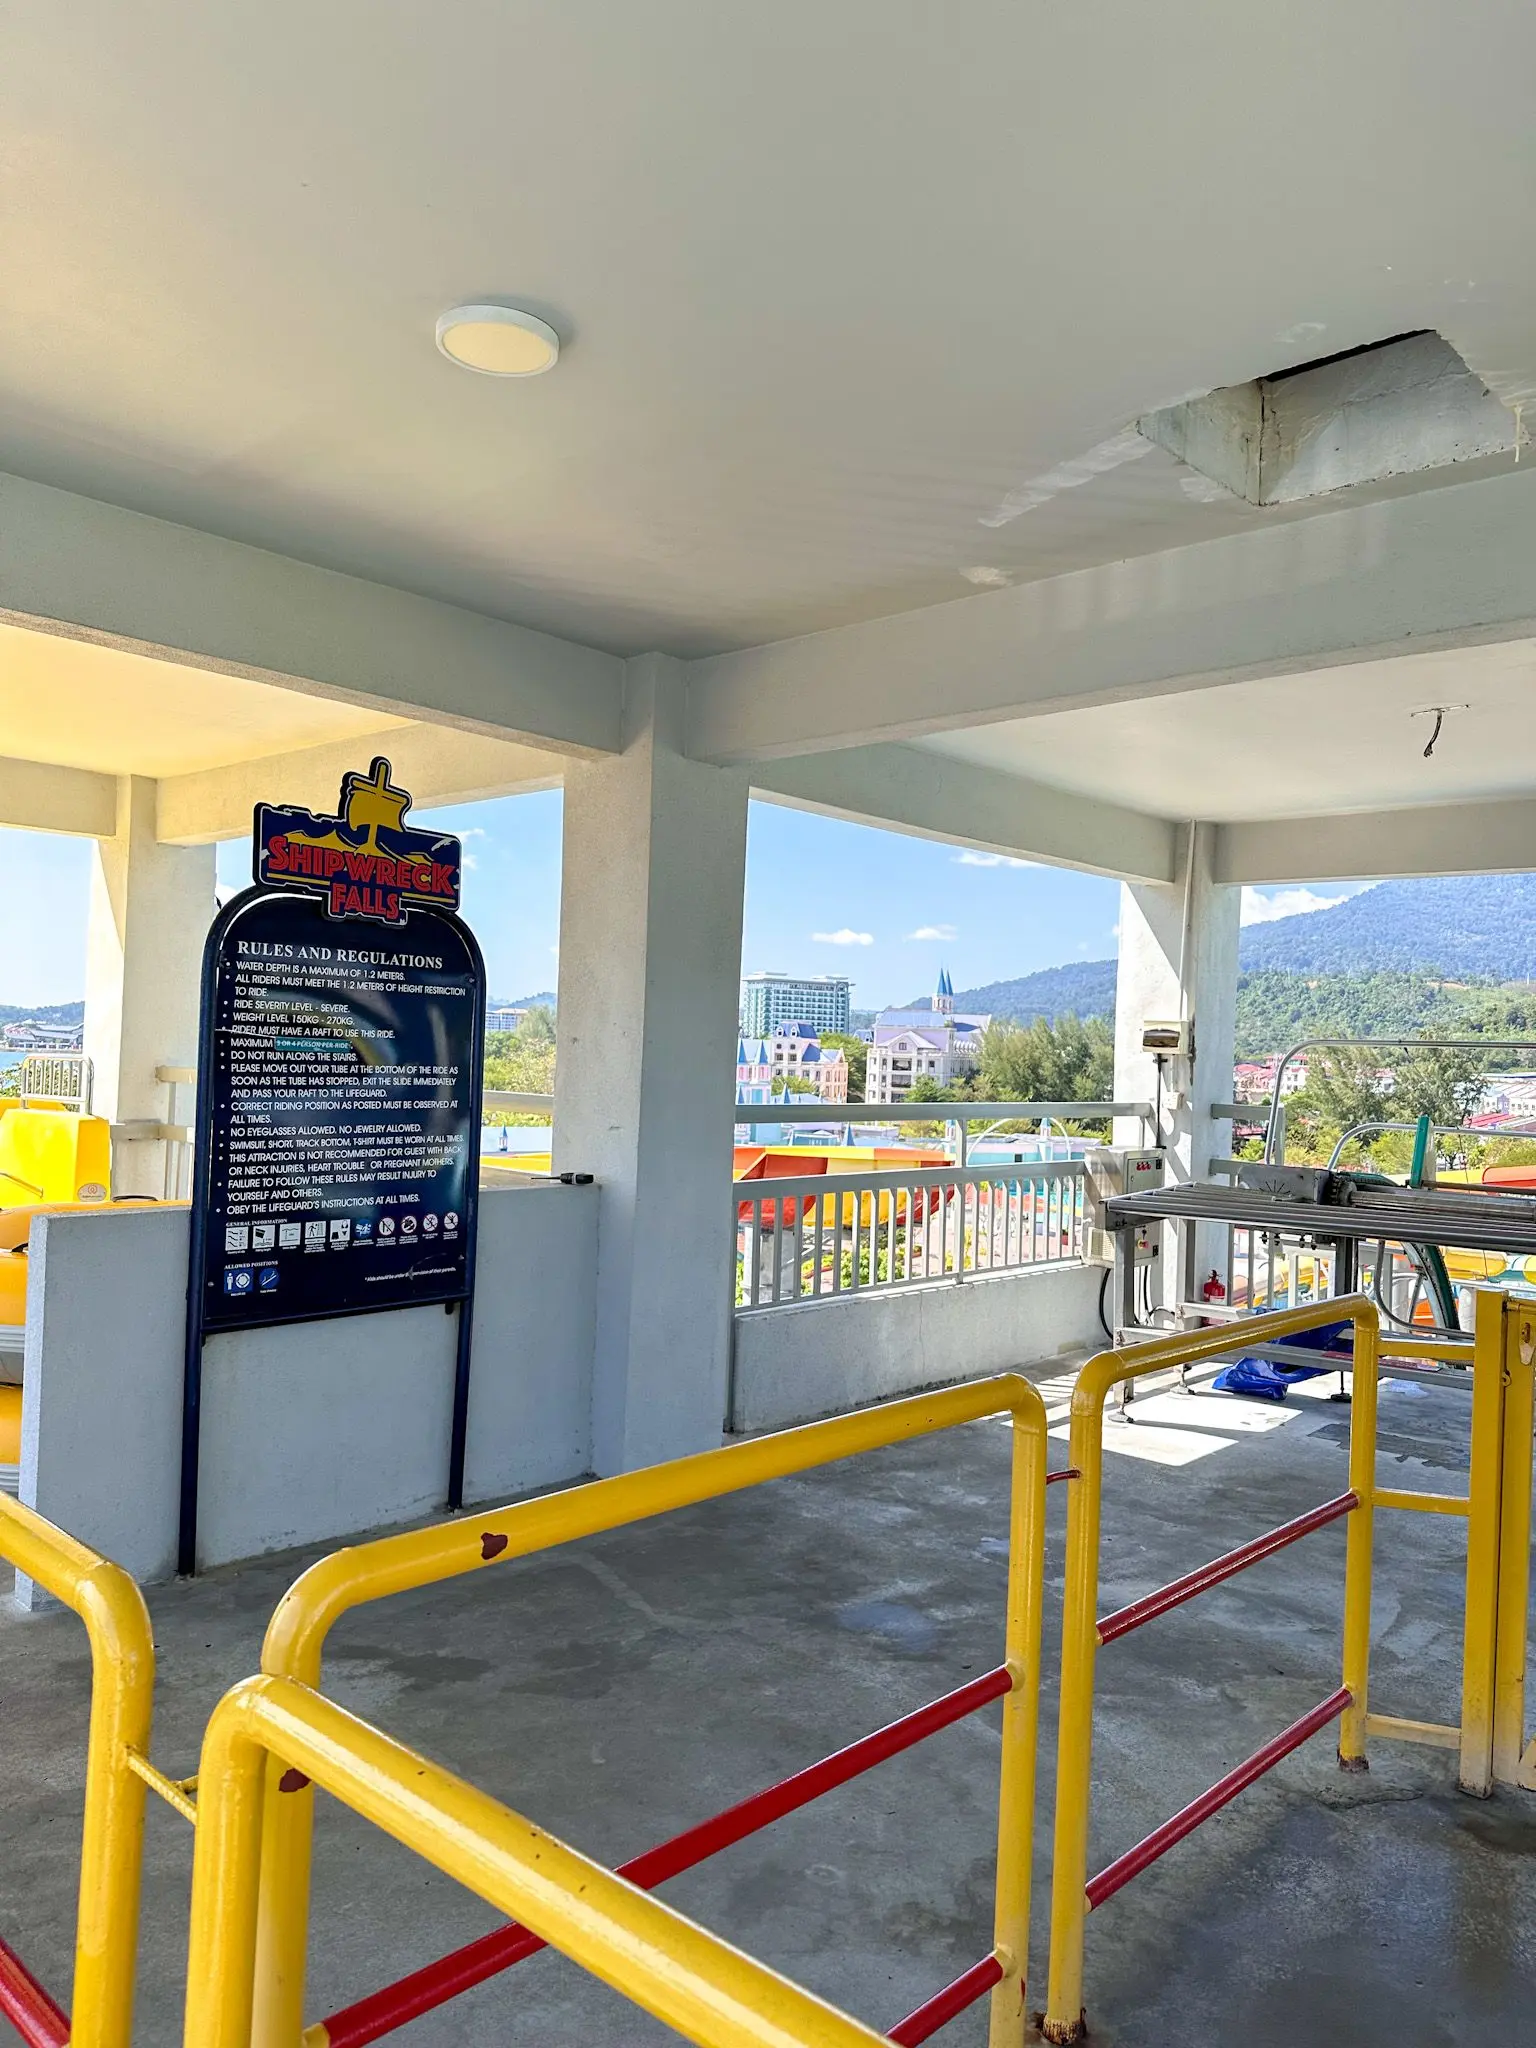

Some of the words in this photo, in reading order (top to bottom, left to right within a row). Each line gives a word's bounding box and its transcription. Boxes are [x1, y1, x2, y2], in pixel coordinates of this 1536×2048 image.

[268, 835, 456, 895] SHIPWRECK
[331, 883, 399, 920] FALLS
[237, 941, 293, 957] RULES
[298, 946, 331, 960] AND
[337, 949, 443, 969] REGULATIONS
[236, 961, 263, 971] WATER
[266, 963, 290, 972] DEPTH
[293, 965, 299, 973] IS
[309, 966, 348, 977] MAXIMUM
[350, 969, 361, 977] OF
[364, 970, 375, 978] 1.2
[377, 971, 405, 980] METERS.
[235, 974, 250, 983] ALL
[252, 975, 280, 984] RIDERS
[282, 977, 303, 986] MUST
[305, 979, 325, 987] MEET
[327, 980, 340, 988] THE
[344, 981, 354, 989] 1.2
[357, 982, 384, 991] METERS
[386, 983, 396, 991] OF
[398, 985, 423, 993] HEIGHT
[425, 986, 465, 996] RESTRICTION
[235, 986, 246, 995] TO
[248, 987, 269, 996] RIDE.
[234, 1000, 253, 1009] RIDE
[255, 1001, 289, 1010] SEVERITY
[292, 1002, 313, 1011] LEVEL
[321, 1004, 350, 1013] SEVERE.
[233, 1012, 264, 1021] WEIGHT
[267, 1014, 289, 1022] LEVEL
[292, 1015, 319, 1024] 150KG
[327, 1016, 354, 1025] 270KG.
[232, 1025, 256, 1034] RIDER
[258, 1026, 279, 1035] MUST
[282, 1027, 302, 1036] HAVE
[304, 1028, 309, 1036] A
[312, 1028, 331, 1036] RAFT
[333, 1029, 343, 1037] TO
[345, 1029, 358, 1037] USE
[361, 1030, 375, 1038] THIS
[377, 1030, 395, 1038] RIDE.
[231, 1038, 273, 1047] MAXIMUM
[231, 1051, 245, 1060] DO
[248, 1051, 265, 1060] NOT
[267, 1051, 284, 1060] RUN
[286, 1052, 315, 1061] ALONG
[317, 1053, 330, 1061] THE
[332, 1053, 358, 1061] STAIRS.
[231, 1064, 260, 1072] PLEASE
[263, 1064, 287, 1073] MOVE
[290, 1065, 306, 1073] OUT
[307, 1065, 329, 1073] YOUR
[331, 1065, 348, 1073] TUBE
[350, 1065, 359, 1073] AT
[360, 1065, 373, 1073] THE
[375, 1066, 405, 1074] BOTTOM
[407, 1066, 417, 1074] OF
[419, 1066, 431, 1074] THE
[433, 1066, 447, 1074] RIDE
[449, 1066, 458, 1074] AS
[231, 1076, 257, 1085] SOON
[259, 1077, 270, 1085] AS
[272, 1077, 287, 1085] THE
[289, 1077, 306, 1085] TUBE
[309, 1077, 324, 1085] HAS
[326, 1077, 360, 1086] STOPPED,
[363, 1077, 377, 1085] EXIT
[379, 1077, 391, 1085] THE
[393, 1077, 411, 1086] SLIDE
[413, 1077, 456, 1086] IMMEDIATELY
[231, 1089, 250, 1098] AND
[253, 1089, 272, 1098] PASS
[273, 1089, 296, 1098] YOUR
[298, 1089, 316, 1098] RAFT
[318, 1089, 328, 1097] TO
[330, 1089, 343, 1097] THE
[346, 1089, 387, 1098] LIFEGUARD.
[231, 1102, 272, 1111] CORRECT
[274, 1102, 302, 1111] RIDING
[305, 1101, 340, 1110] POSITION
[341, 1101, 352, 1110] AS
[354, 1101, 381, 1109] POSTED
[383, 1101, 401, 1109] MUST
[403, 1101, 412, 1109] BE
[413, 1100, 449, 1109] OBSERVED
[450, 1100, 458, 1108] AT
[230, 1115, 245, 1124] ALL
[247, 1114, 272, 1124] TIMES.
[231, 1128, 245, 1137] NO
[247, 1127, 296, 1136] EYEGLASSES
[339, 1125, 352, 1134] NO
[354, 1125, 385, 1134] JEWELRY
[386, 1124, 422, 1133] ALLOWED.
[268, 1140, 293, 1149] SHORT,
[296, 1139, 319, 1147] TRACK
[321, 1138, 351, 1147] BOTTOM,
[353, 1137, 375, 1146] T-SHIRT
[377, 1137, 394, 1145] MUST
[395, 1136, 403, 1144] BE
[405, 1136, 425, 1144] WORN
[427, 1135, 434, 1143] AT
[435, 1135, 445, 1143] ALL
[229, 1154, 245, 1162] THIS
[248, 1152, 297, 1162] ATTRACTION
[299, 1152, 305, 1160] IS
[307, 1151, 323, 1160] NOT
[325, 1148, 386, 1159] RECOMMENDED
[387, 1148, 402, 1156] FOR
[404, 1147, 426, 1156] GUEST
[427, 1146, 442, 1154] WITH
[229, 1167, 242, 1176] OR
[245, 1166, 269, 1175] NECK
[270, 1164, 305, 1174] INJURIES,
[308, 1163, 331, 1172] HEART
[333, 1161, 364, 1170] TROUBLE
[370, 1161, 382, 1169] OR
[384, 1159, 421, 1168] PREGNANT
[422, 1158, 454, 1166] MOTHERS.
[228, 1179, 260, 1188] FAILURE
[263, 1178, 273, 1187] TO
[276, 1176, 310, 1186] FOLLOW
[312, 1175, 334, 1184] THESE
[336, 1174, 358, 1183] RULES
[360, 1173, 375, 1182] MAY
[377, 1171, 401, 1180] RESULT
[402, 1171, 426, 1179] INJURY
[427, 1170, 436, 1178] TO
[227, 1191, 269, 1201] YOURSELF
[270, 1190, 290, 1199] AND
[292, 1188, 323, 1198] OTHERS.
[227, 1205, 250, 1214] OBEY
[252, 1204, 266, 1213] THE
[269, 1200, 319, 1212] LIFEGUARD'S
[322, 1197, 374, 1208] INSTRUCTIONS
[375, 1196, 384, 1205] AT
[385, 1196, 398, 1204] ALL
[399, 1194, 420, 1203] TIMES.
